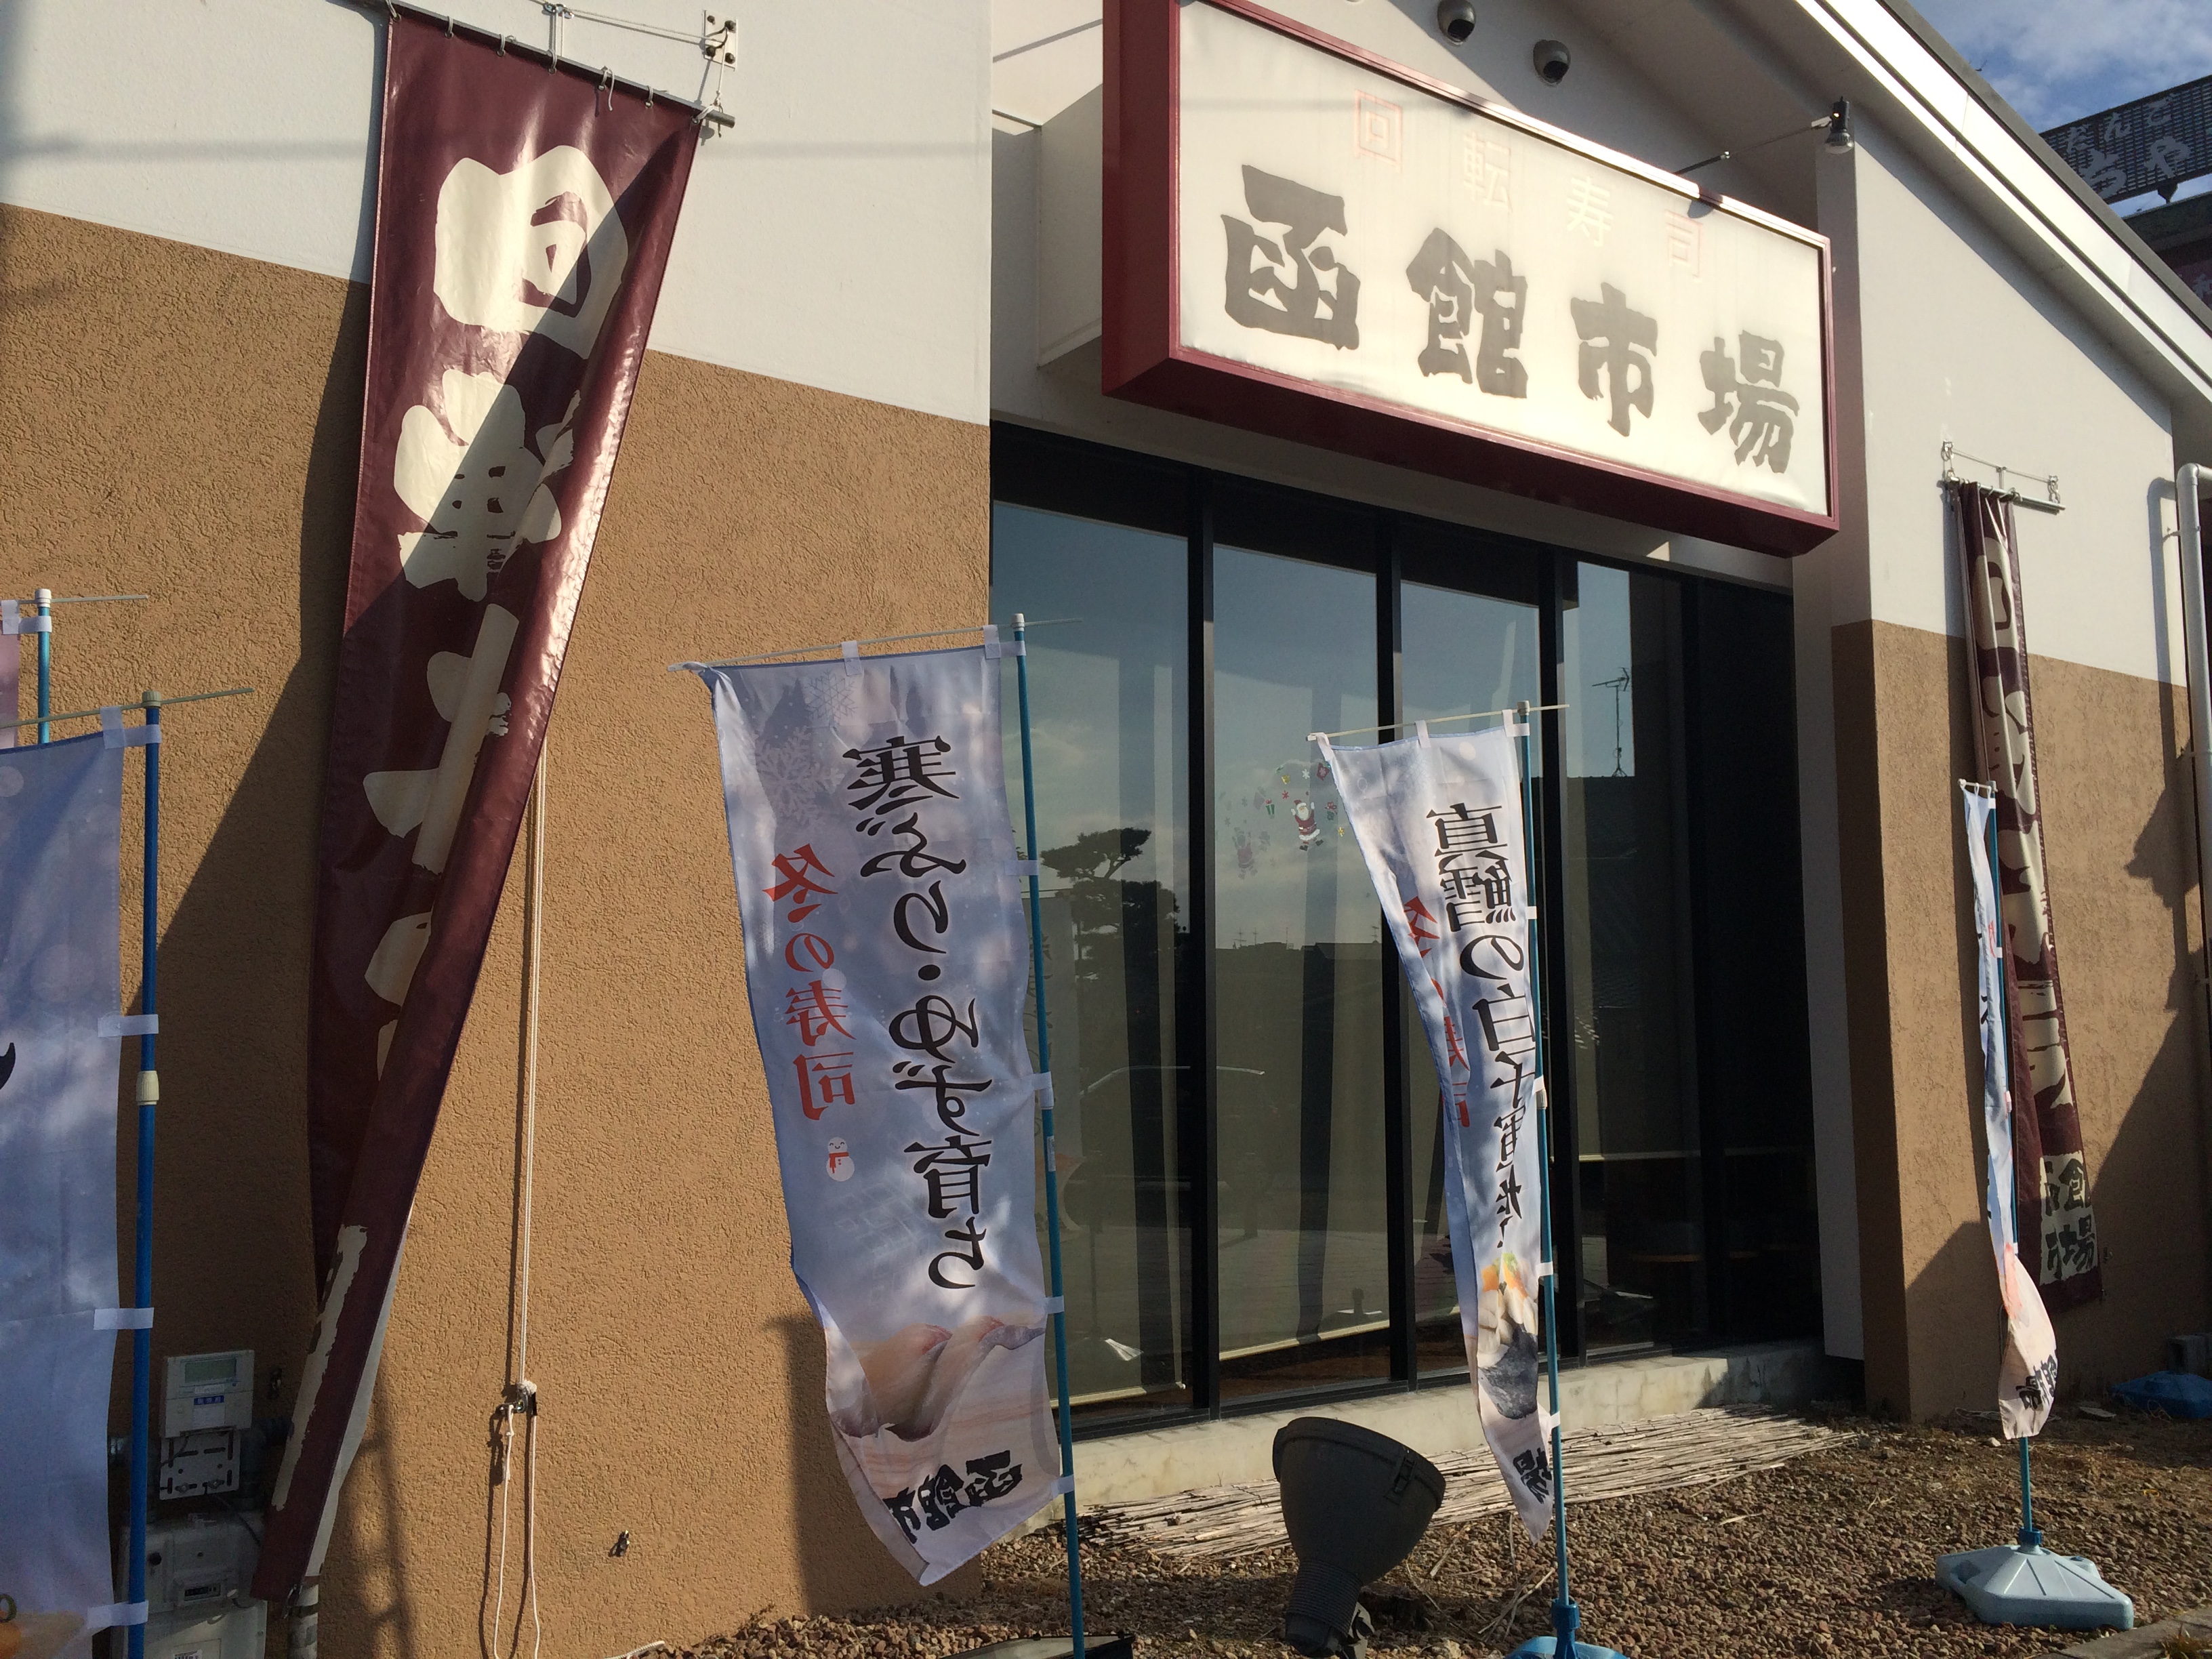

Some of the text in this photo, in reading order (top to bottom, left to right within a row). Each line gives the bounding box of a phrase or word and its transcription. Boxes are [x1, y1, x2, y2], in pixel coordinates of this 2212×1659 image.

[1353, 89, 1705, 283] 回転寿司
[1220, 163, 1800, 474] 函館市場
